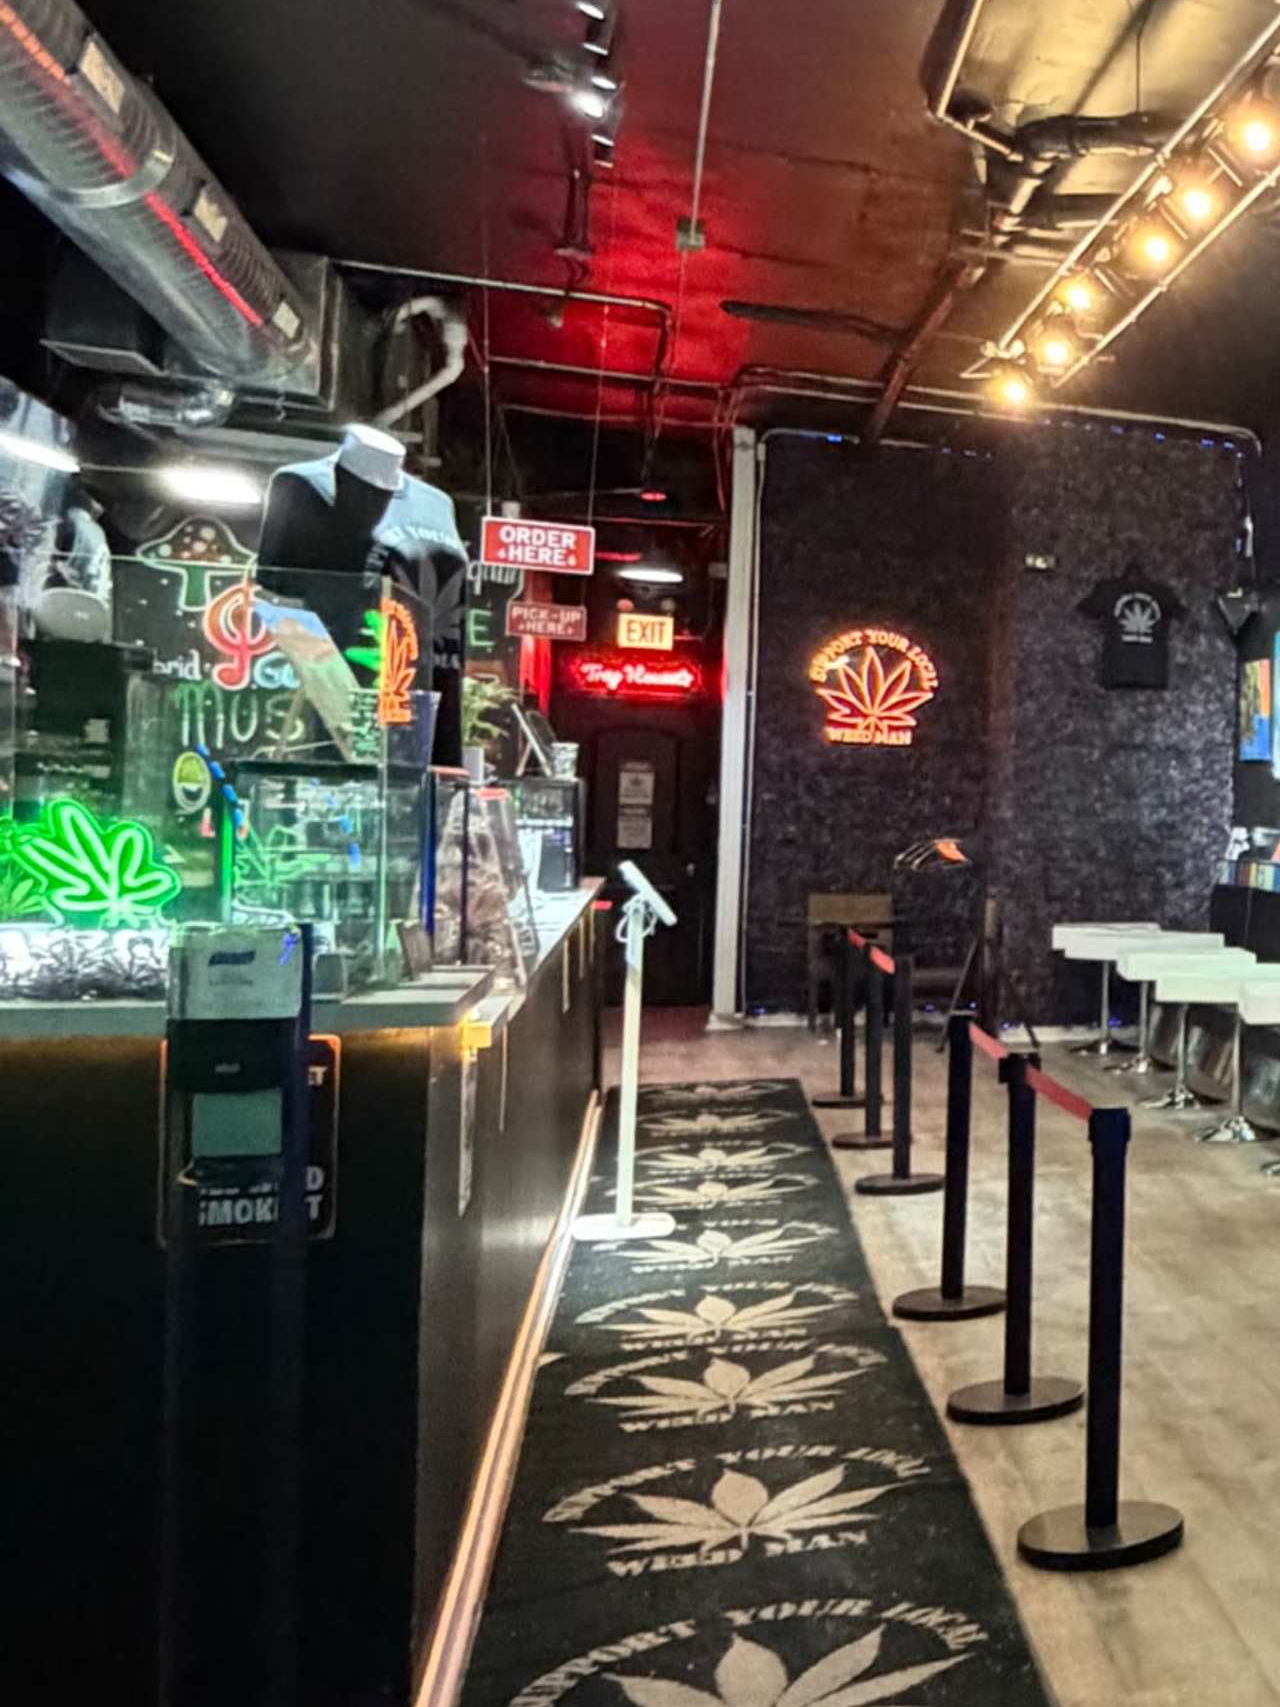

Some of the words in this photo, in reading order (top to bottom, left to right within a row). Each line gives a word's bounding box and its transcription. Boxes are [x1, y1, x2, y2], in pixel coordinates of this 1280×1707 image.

[499, 525, 577, 550] ORDER
[508, 547, 569, 566] HERE
[625, 619, 667, 644] EXIT
